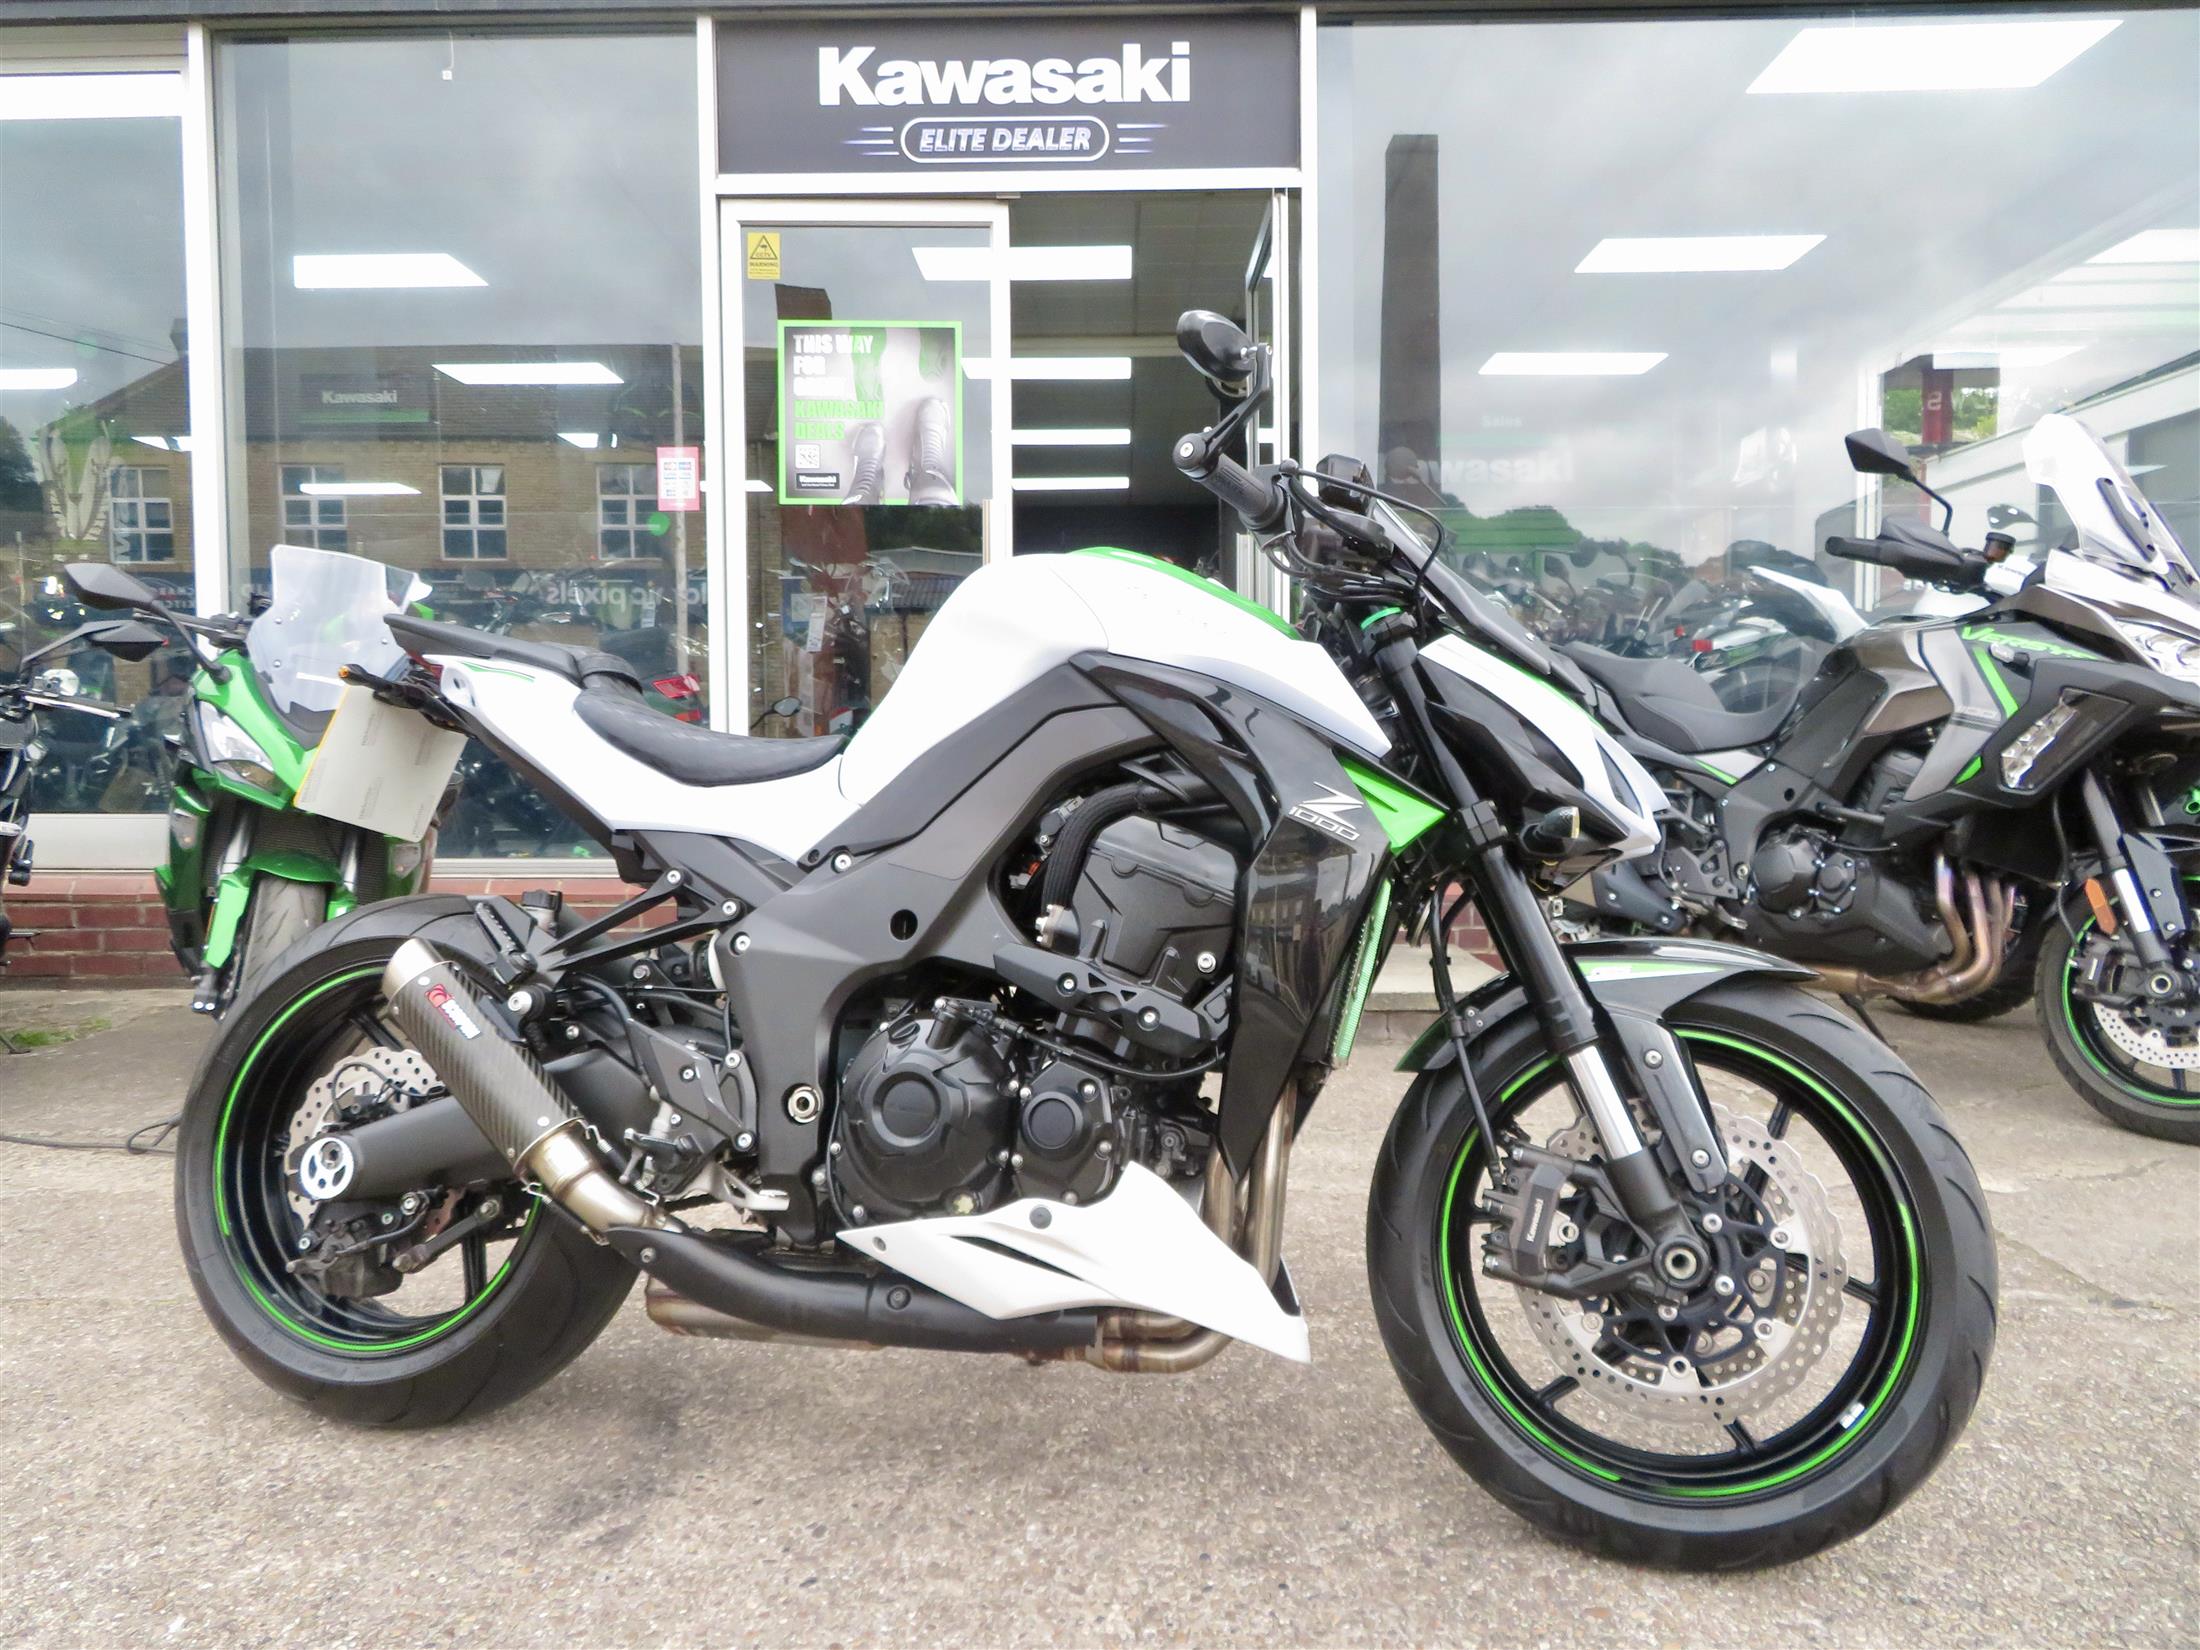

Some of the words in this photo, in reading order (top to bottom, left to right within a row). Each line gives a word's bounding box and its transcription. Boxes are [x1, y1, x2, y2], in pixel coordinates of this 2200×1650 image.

[818, 41, 1191, 105] Kawasaki
[919, 127, 987, 152] ELITE
[992, 126, 1091, 151] DEALER
[835, 335, 873, 353] WAY
[322, 389, 397, 404] Kawasaki
